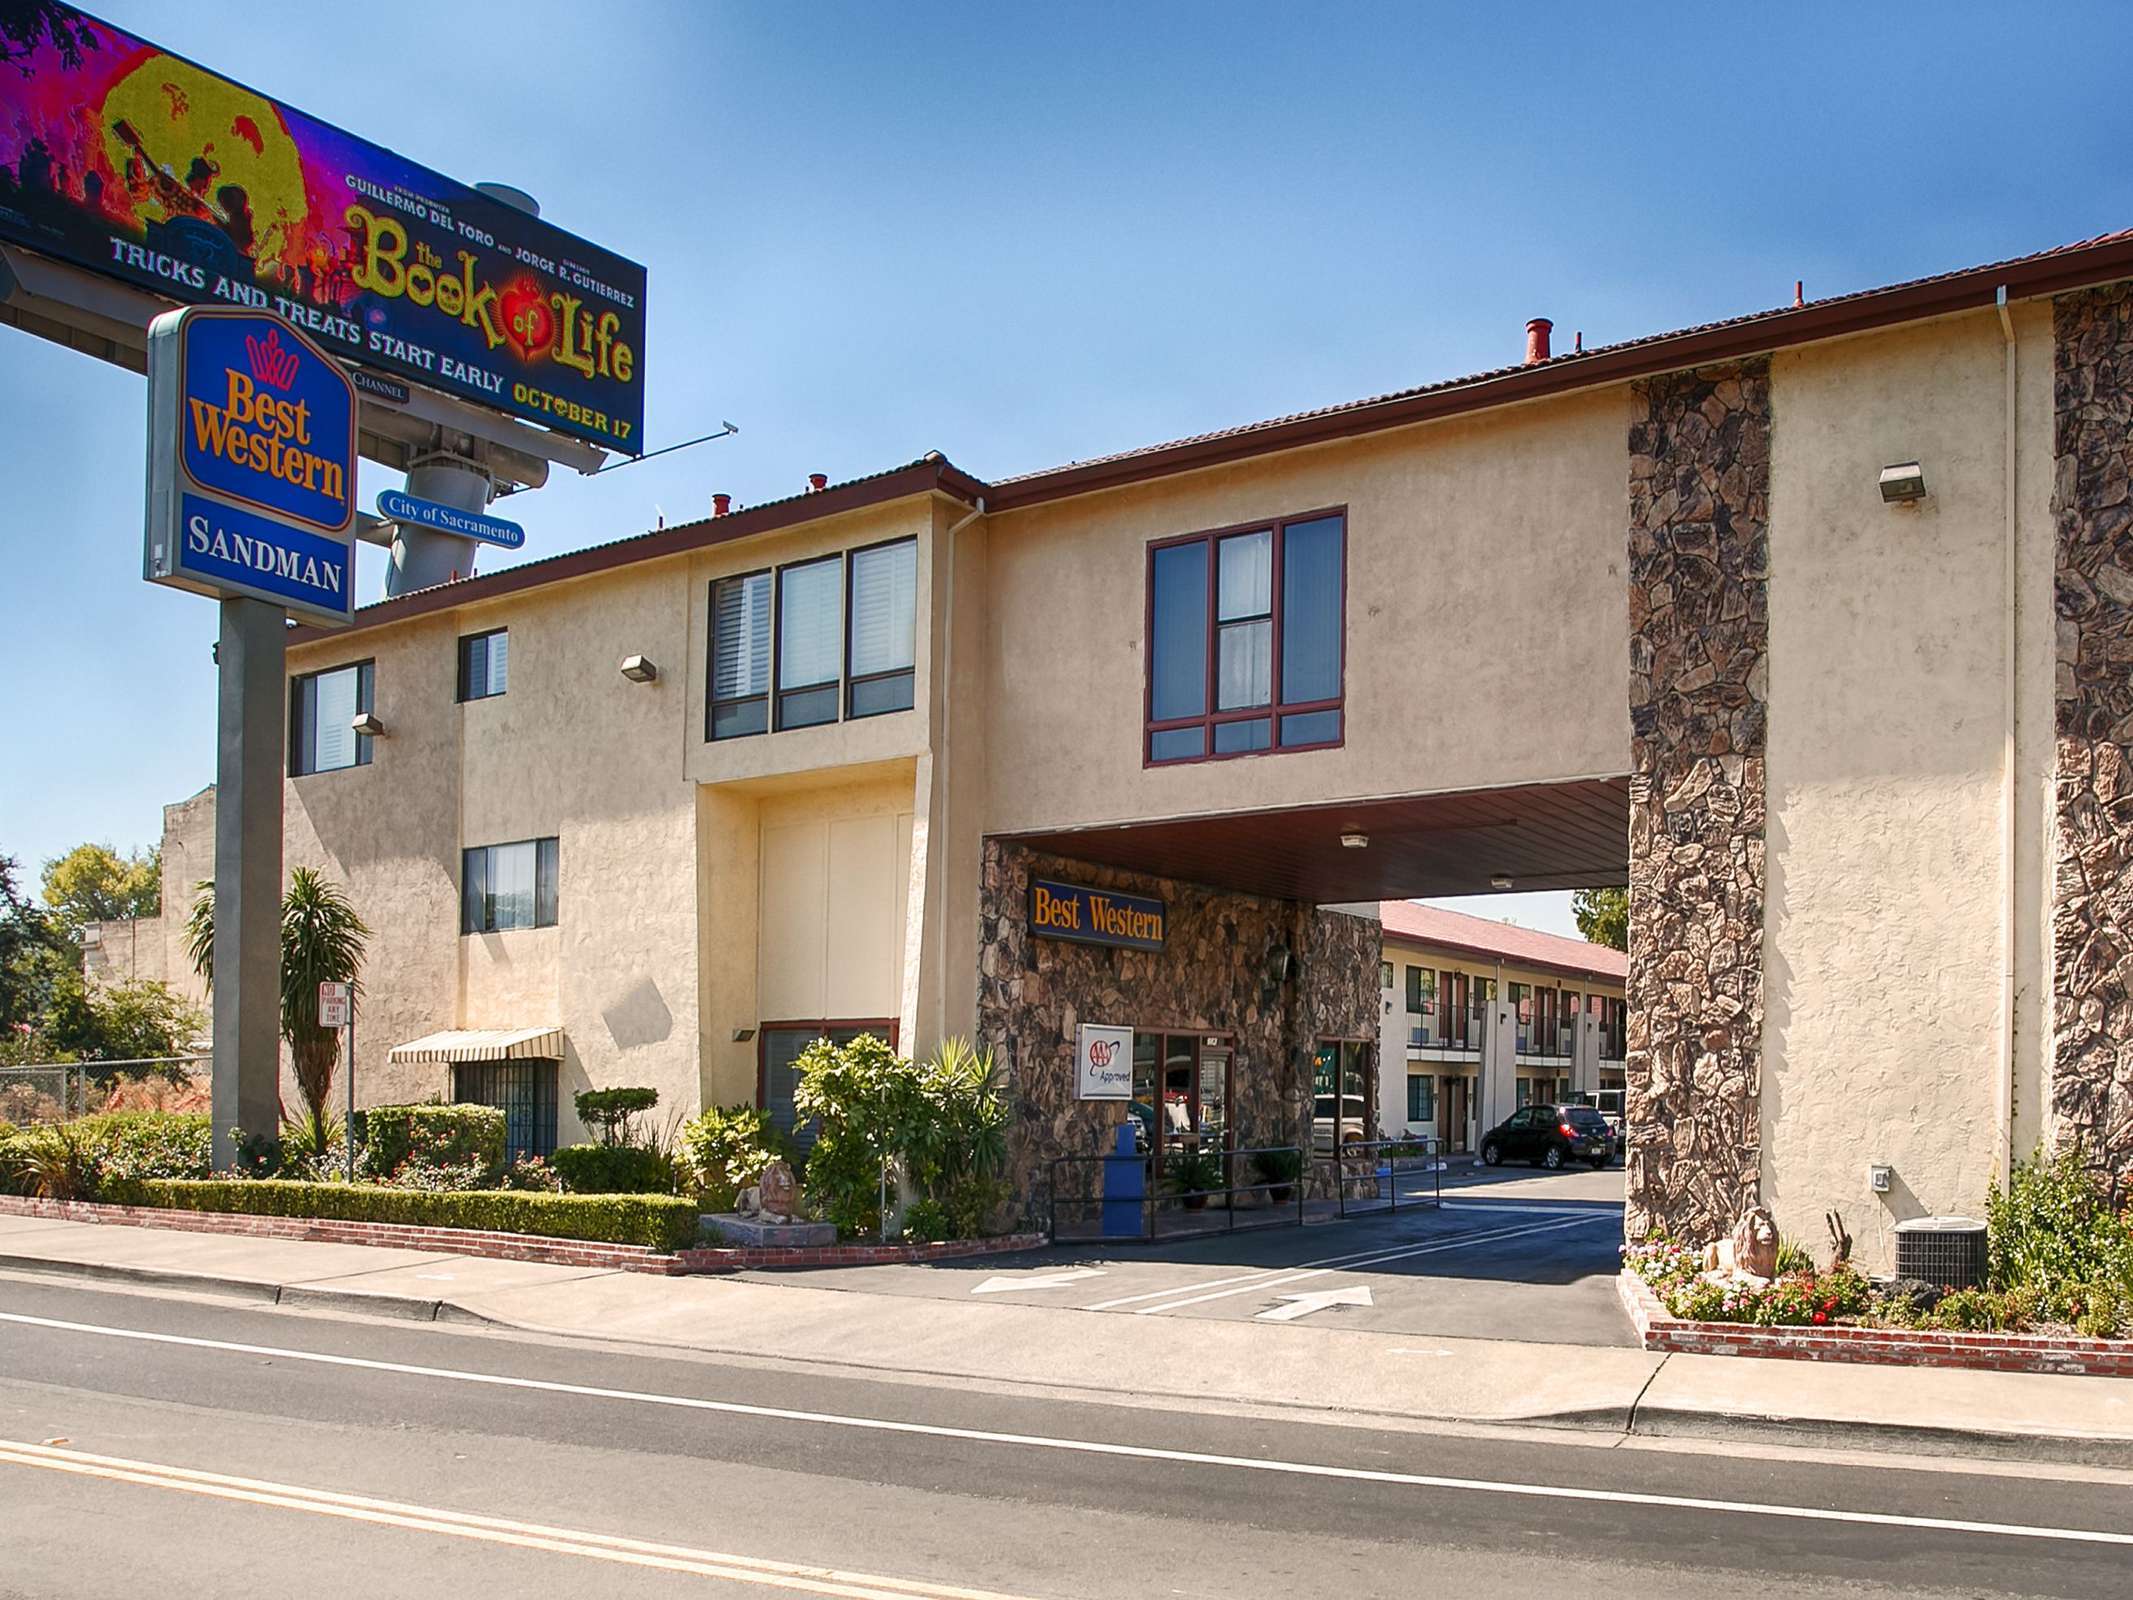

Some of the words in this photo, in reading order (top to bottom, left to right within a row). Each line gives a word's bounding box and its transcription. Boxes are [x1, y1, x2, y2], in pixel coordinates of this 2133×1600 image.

[345, 174, 427, 219] GUILLERMO
[430, 208, 455, 231] DEL
[457, 221, 494, 247] TORO
[515, 248, 556, 275] JORGE
[559, 265, 571, 282] R.
[572, 273, 635, 309] GUTIERREZ
[415, 241, 442, 269] the
[344, 204, 506, 350] Book
[513, 308, 538, 346] of
[551, 291, 634, 382] Life
[110, 236, 206, 289] TRICKS
[212, 275, 270, 309] AND
[274, 297, 361, 344] TREATS
[369, 331, 435, 370] START
[440, 355, 504, 394] EARLY
[513, 383, 608, 432] OCTOBER
[613, 419, 632, 439] 17
[225, 367, 311, 446] Best
[352, 371, 404, 398] CHANNEL
[189, 396, 345, 500] Western
[189, 515, 342, 593] SANDMAN
[389, 497, 419, 520] City
[423, 507, 438, 521] of
[440, 511, 519, 543] Sacramento
[1034, 887, 1081, 930] Best
[1089, 895, 1163, 941] Western
